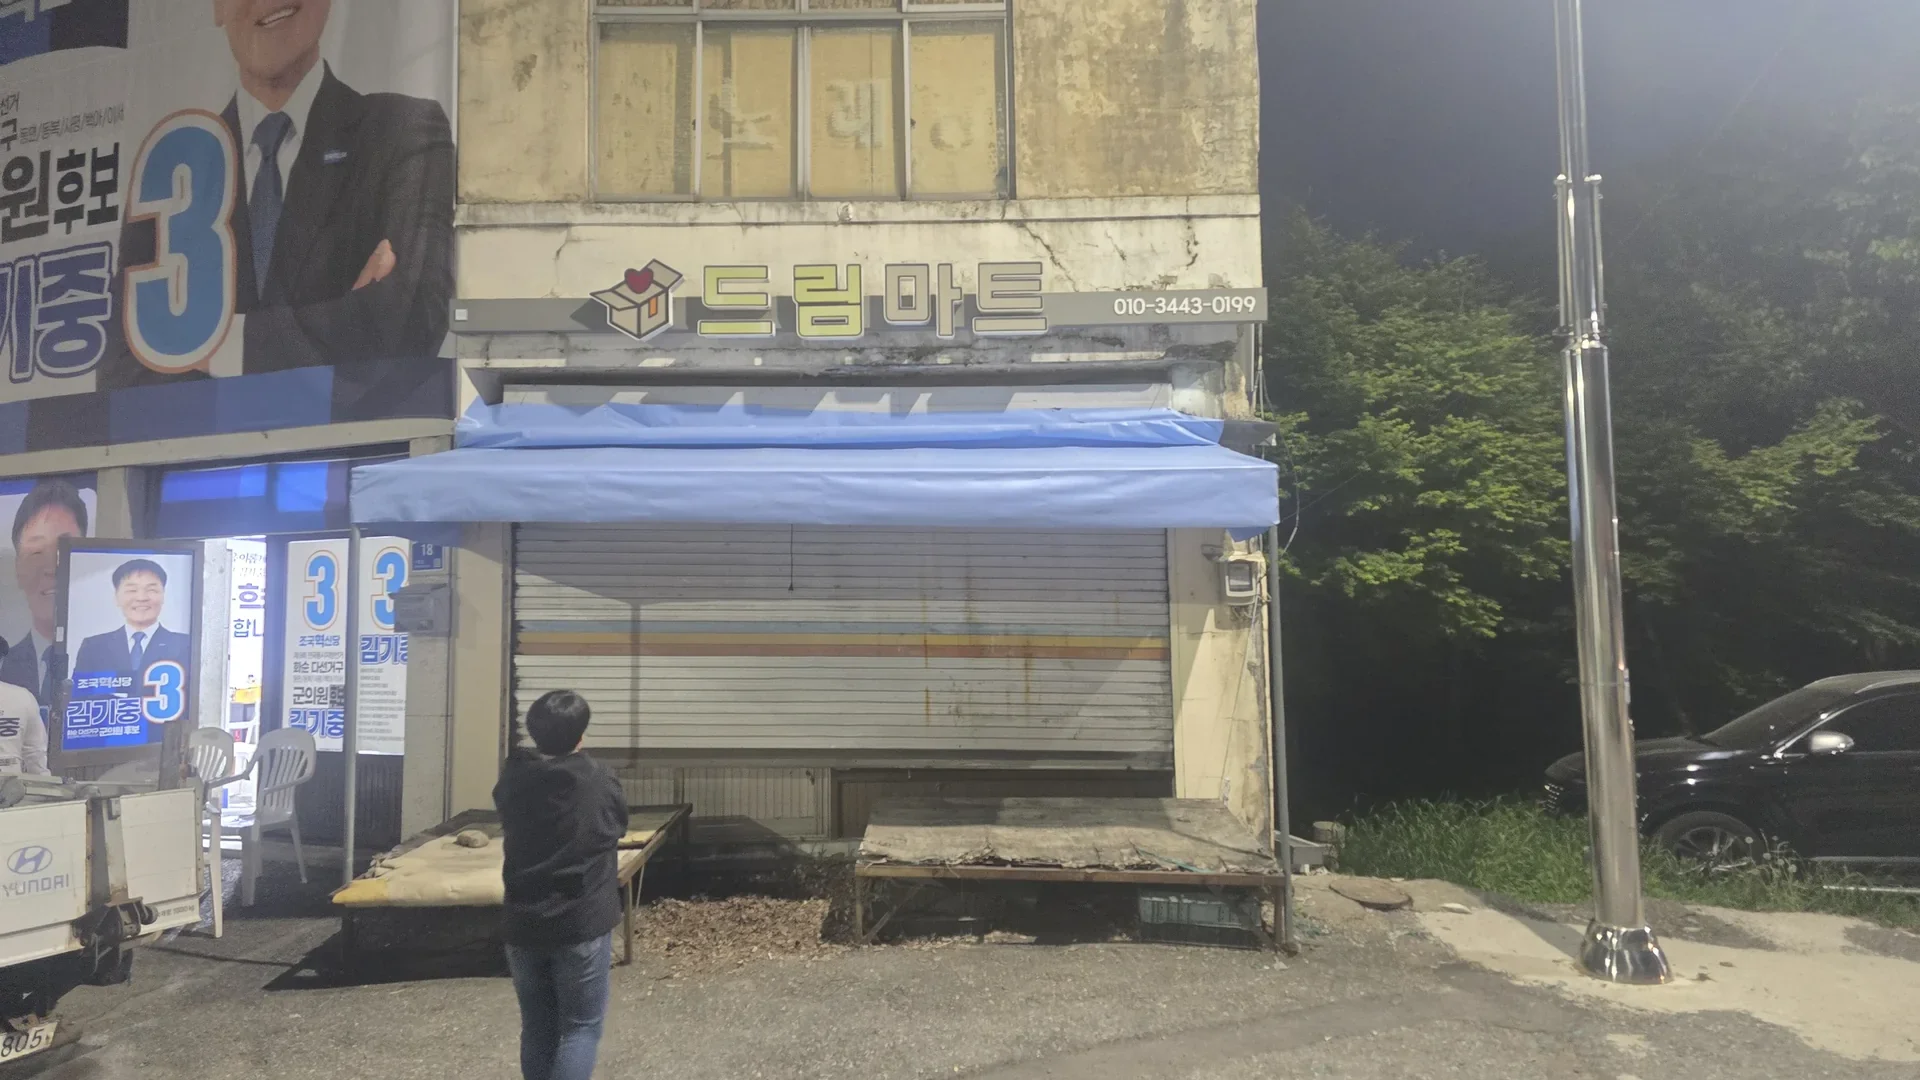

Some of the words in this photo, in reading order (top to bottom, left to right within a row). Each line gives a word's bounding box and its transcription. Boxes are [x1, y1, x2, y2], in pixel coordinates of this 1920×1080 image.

[123, 108, 238, 374] 3
[698, 262, 1048, 339] 드림마트
[1113, 296, 1257, 315] 010-3443-0199
[420, 543, 433, 557] 18
[303, 549, 339, 631] 3
[371, 546, 409, 631] 3
[299, 634, 340, 647] 조국혁신당
[77, 677, 132, 689] 조국혁신당
[143, 660, 184, 724] 3
[66, 697, 141, 728] 김기중
[289, 708, 344, 738] 김기중
